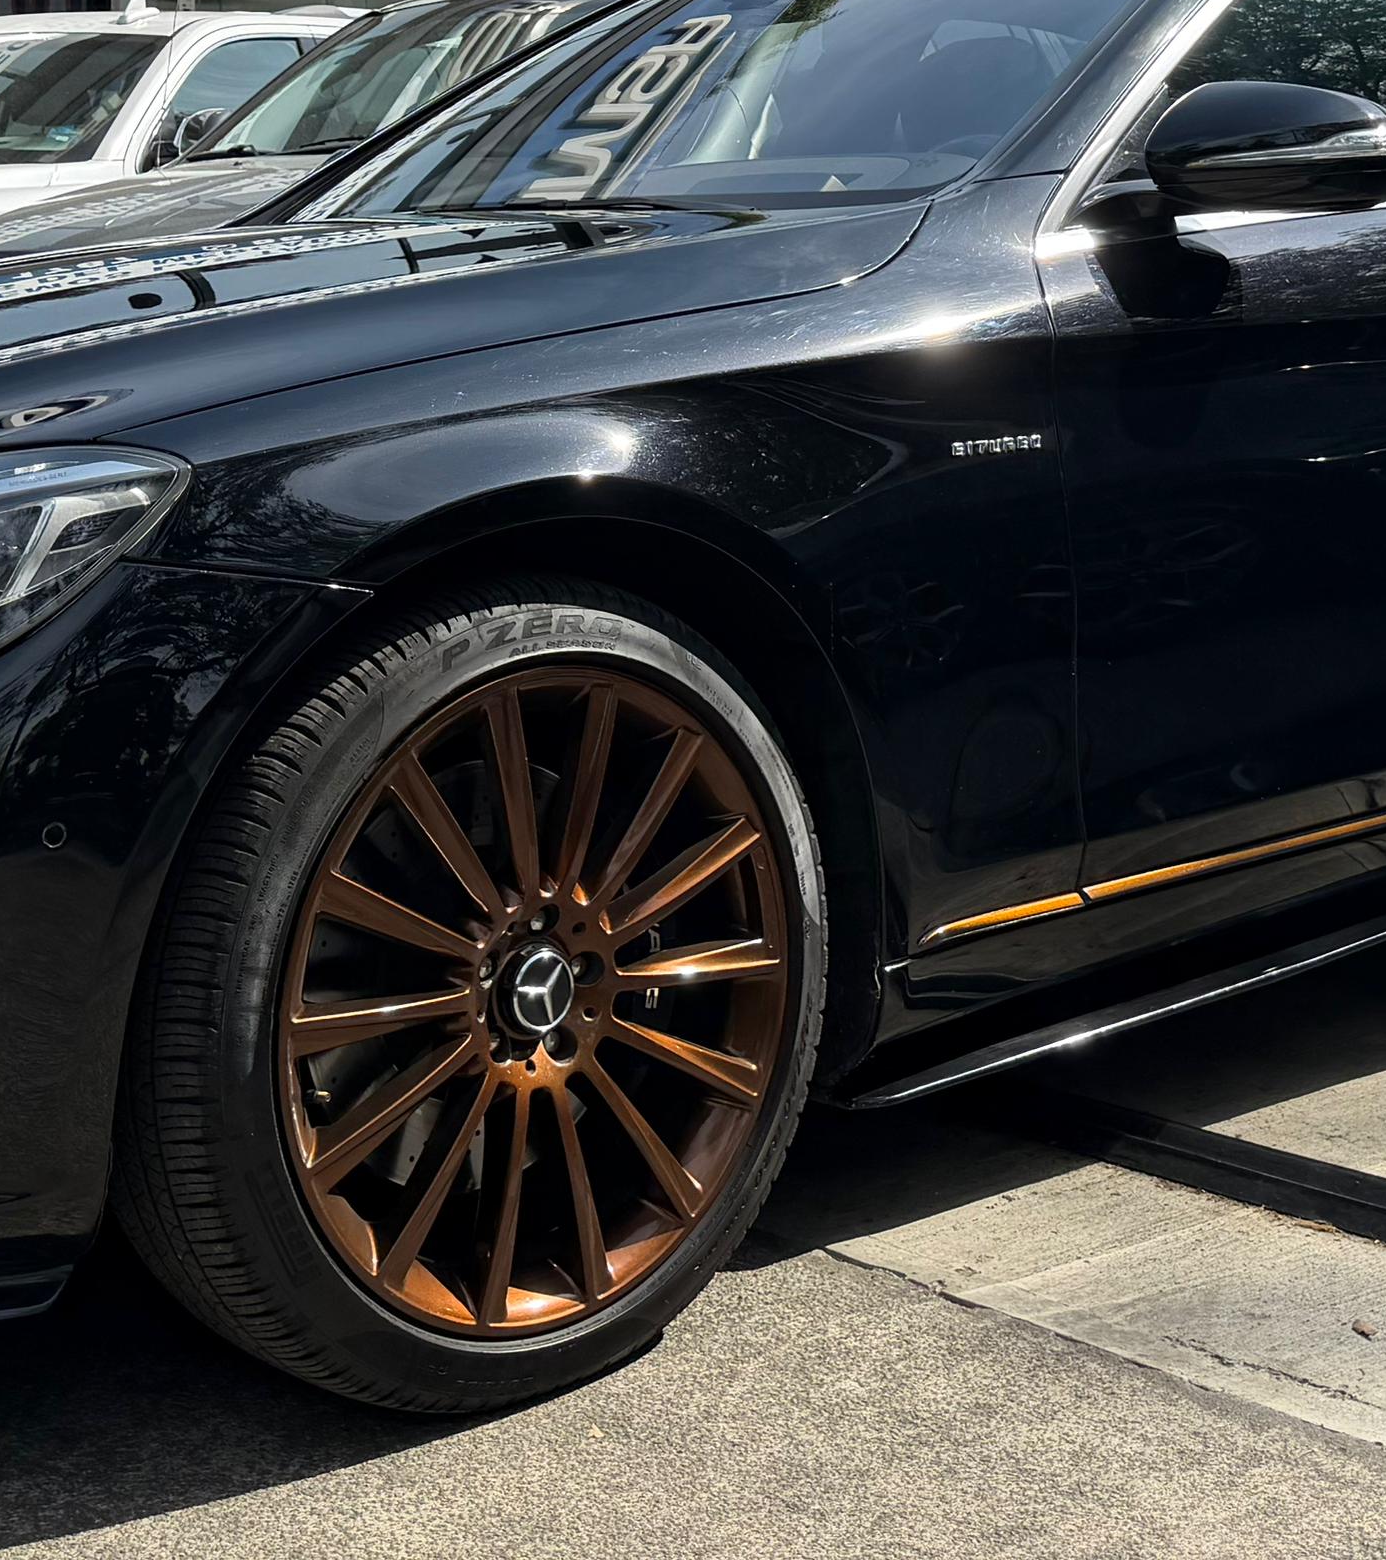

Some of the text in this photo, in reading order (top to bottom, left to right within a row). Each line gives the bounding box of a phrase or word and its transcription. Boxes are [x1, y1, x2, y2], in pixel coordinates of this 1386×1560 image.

[440, 614, 623, 674] P ZERO
[545, 639, 617, 651] SEASON
